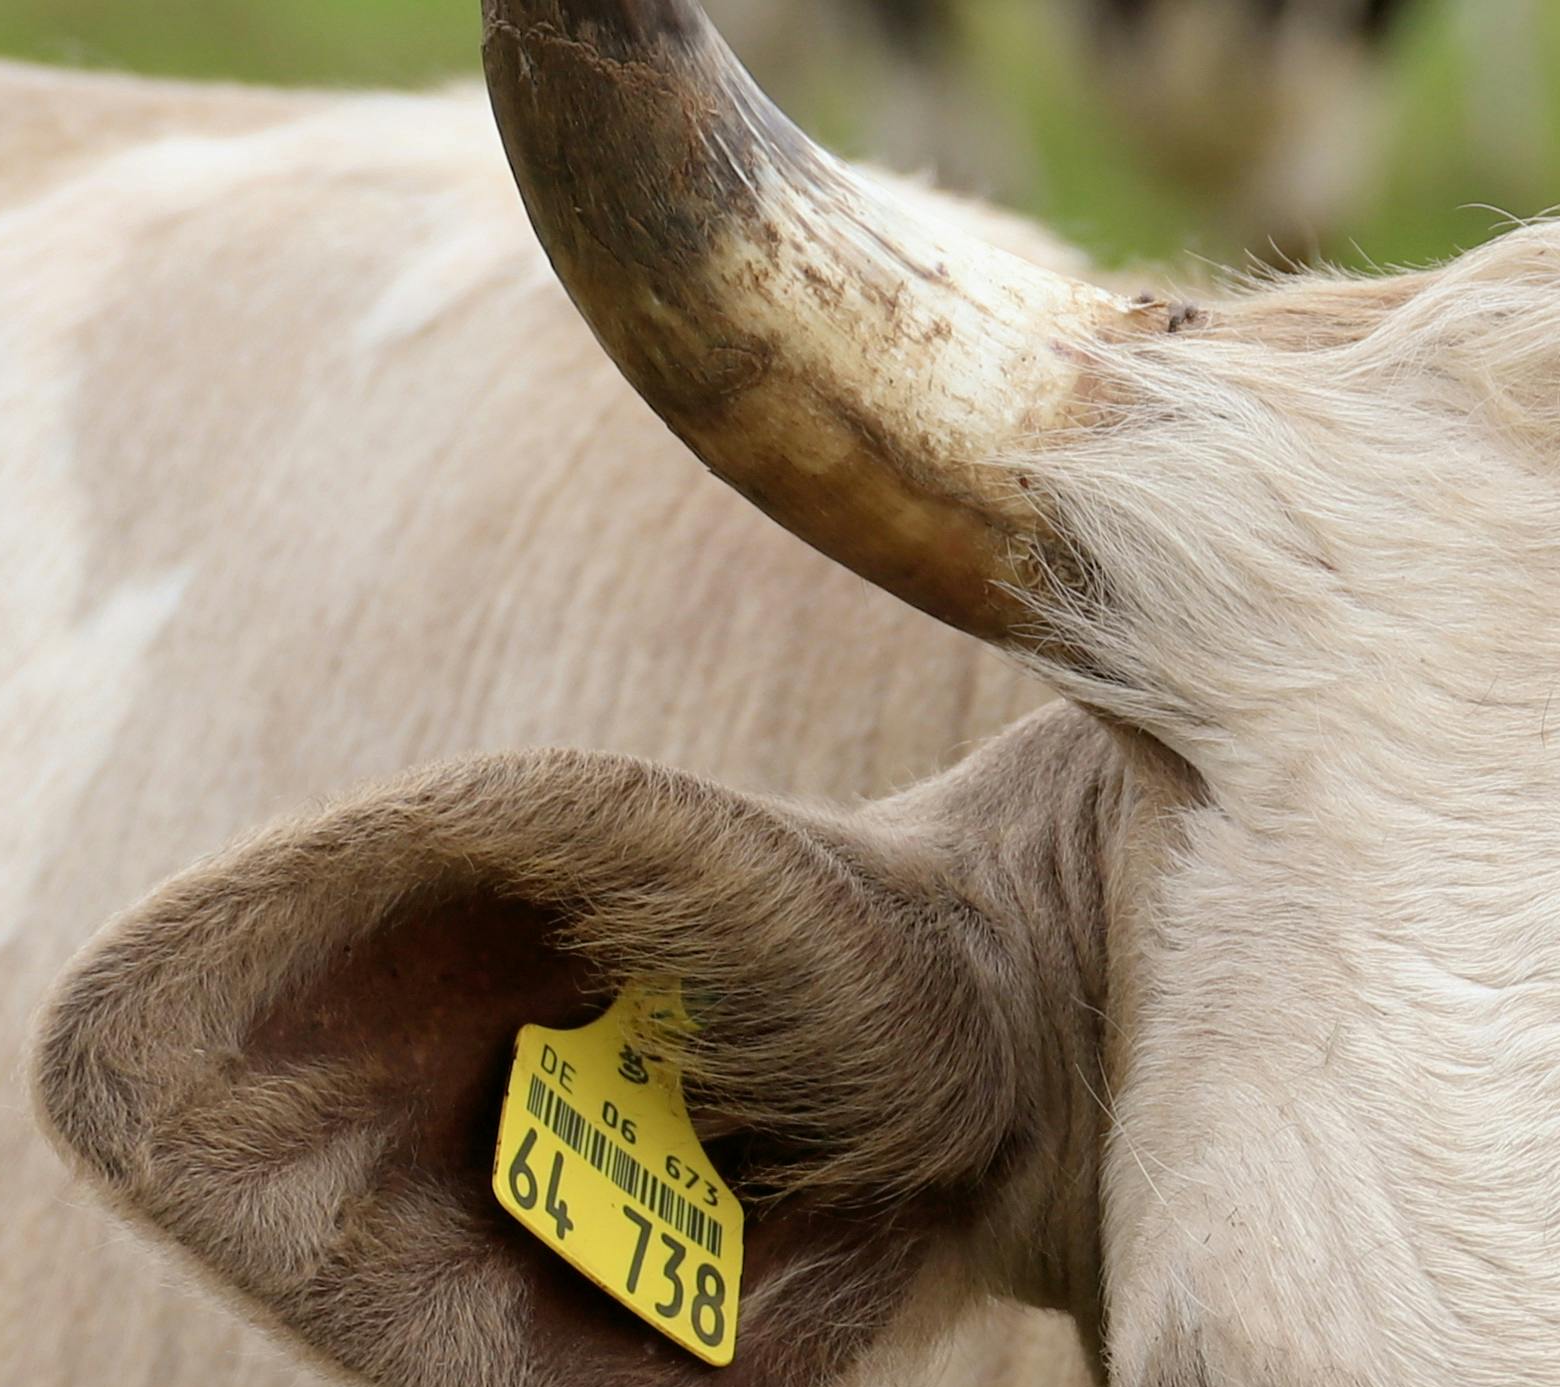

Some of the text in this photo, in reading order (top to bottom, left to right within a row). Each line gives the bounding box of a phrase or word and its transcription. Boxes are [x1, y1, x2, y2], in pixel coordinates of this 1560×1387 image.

[540, 1044, 719, 1206] DE 06 673
[508, 1127, 727, 1347] 64 738
